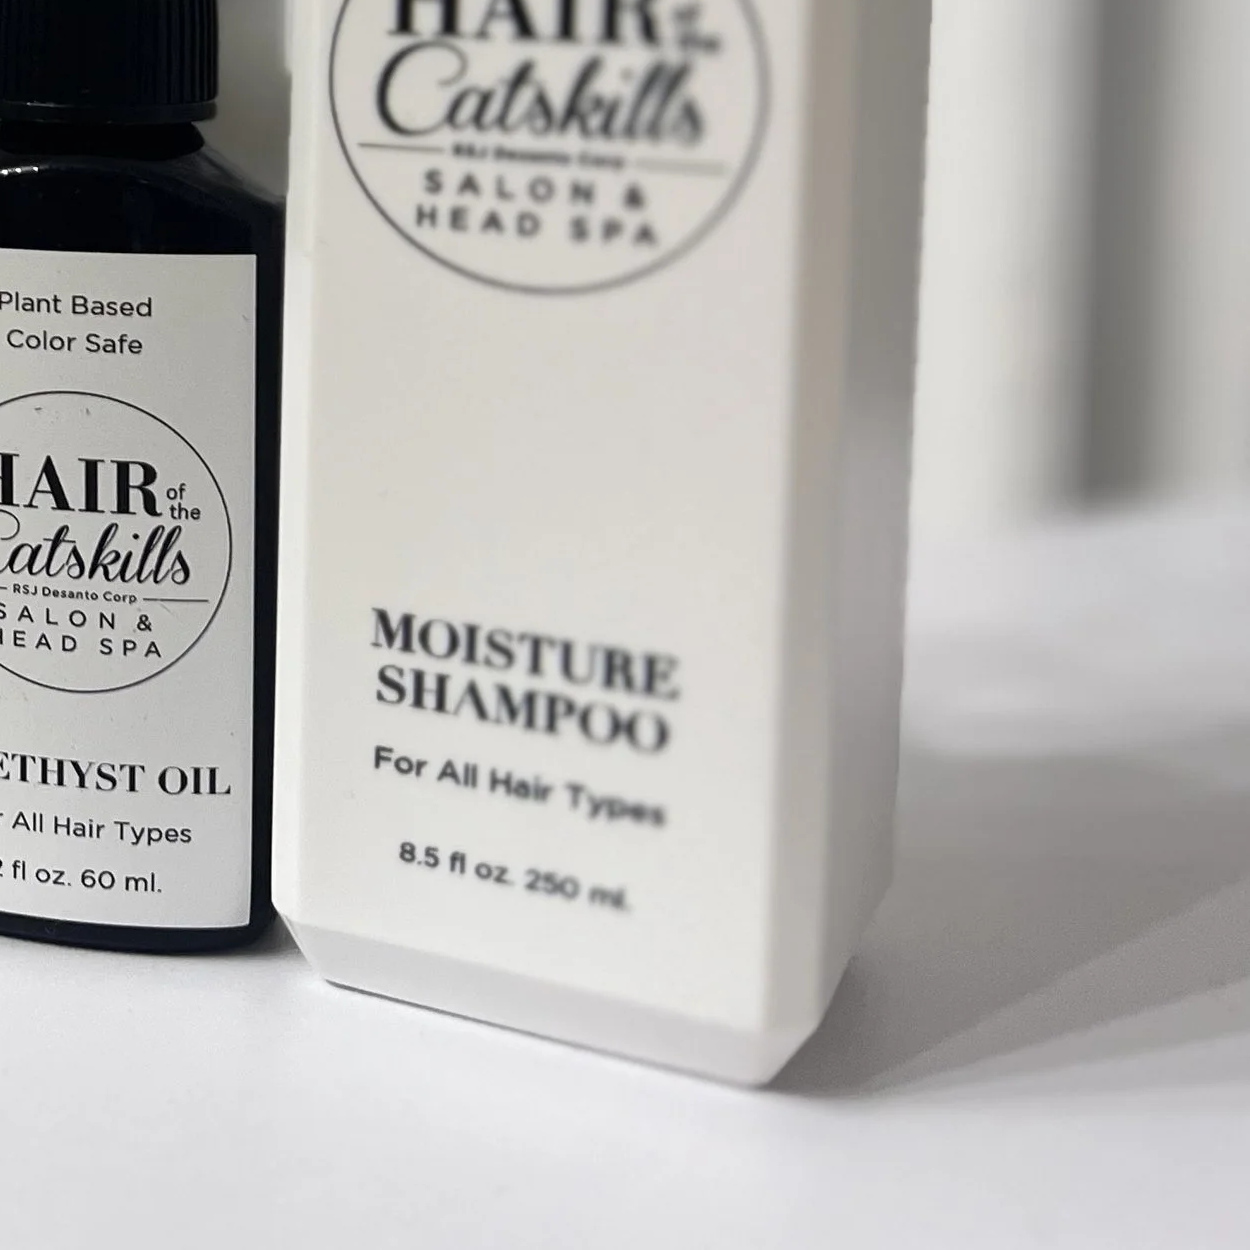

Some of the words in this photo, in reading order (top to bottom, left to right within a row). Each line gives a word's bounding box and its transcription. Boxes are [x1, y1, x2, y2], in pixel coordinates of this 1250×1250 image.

[375, 38, 707, 143] Catskills
[424, 168, 595, 206] SALON
[415, 204, 541, 238] HEAD
[569, 215, 658, 247] SPA
[72, 295, 152, 317] Based
[7, 329, 77, 352] Color
[85, 333, 142, 354] Safe
[166, 483, 186, 500] of
[169, 502, 201, 520] the
[13, 583, 38, 596] RSJ
[42, 586, 98, 601] Desanto
[103, 591, 138, 605] Corp
[137, 614, 152, 632] &
[100, 638, 161, 658] SPA
[371, 608, 680, 701] MOISTURE
[376, 664, 671, 754] SHAMPOO
[158, 766, 231, 796] OIL
[374, 745, 428, 777] For
[437, 759, 478, 789] All
[489, 768, 554, 803] Hair
[12, 811, 43, 833] All
[54, 816, 105, 839] Hair
[114, 821, 191, 846] Types
[12, 860, 25, 881] fl
[35, 866, 72, 886] oz.
[81, 869, 115, 890] 60
[125, 872, 161, 893] ml.
[399, 842, 440, 869] 8.5
[449, 851, 466, 875] fl
[524, 868, 581, 901] 250
